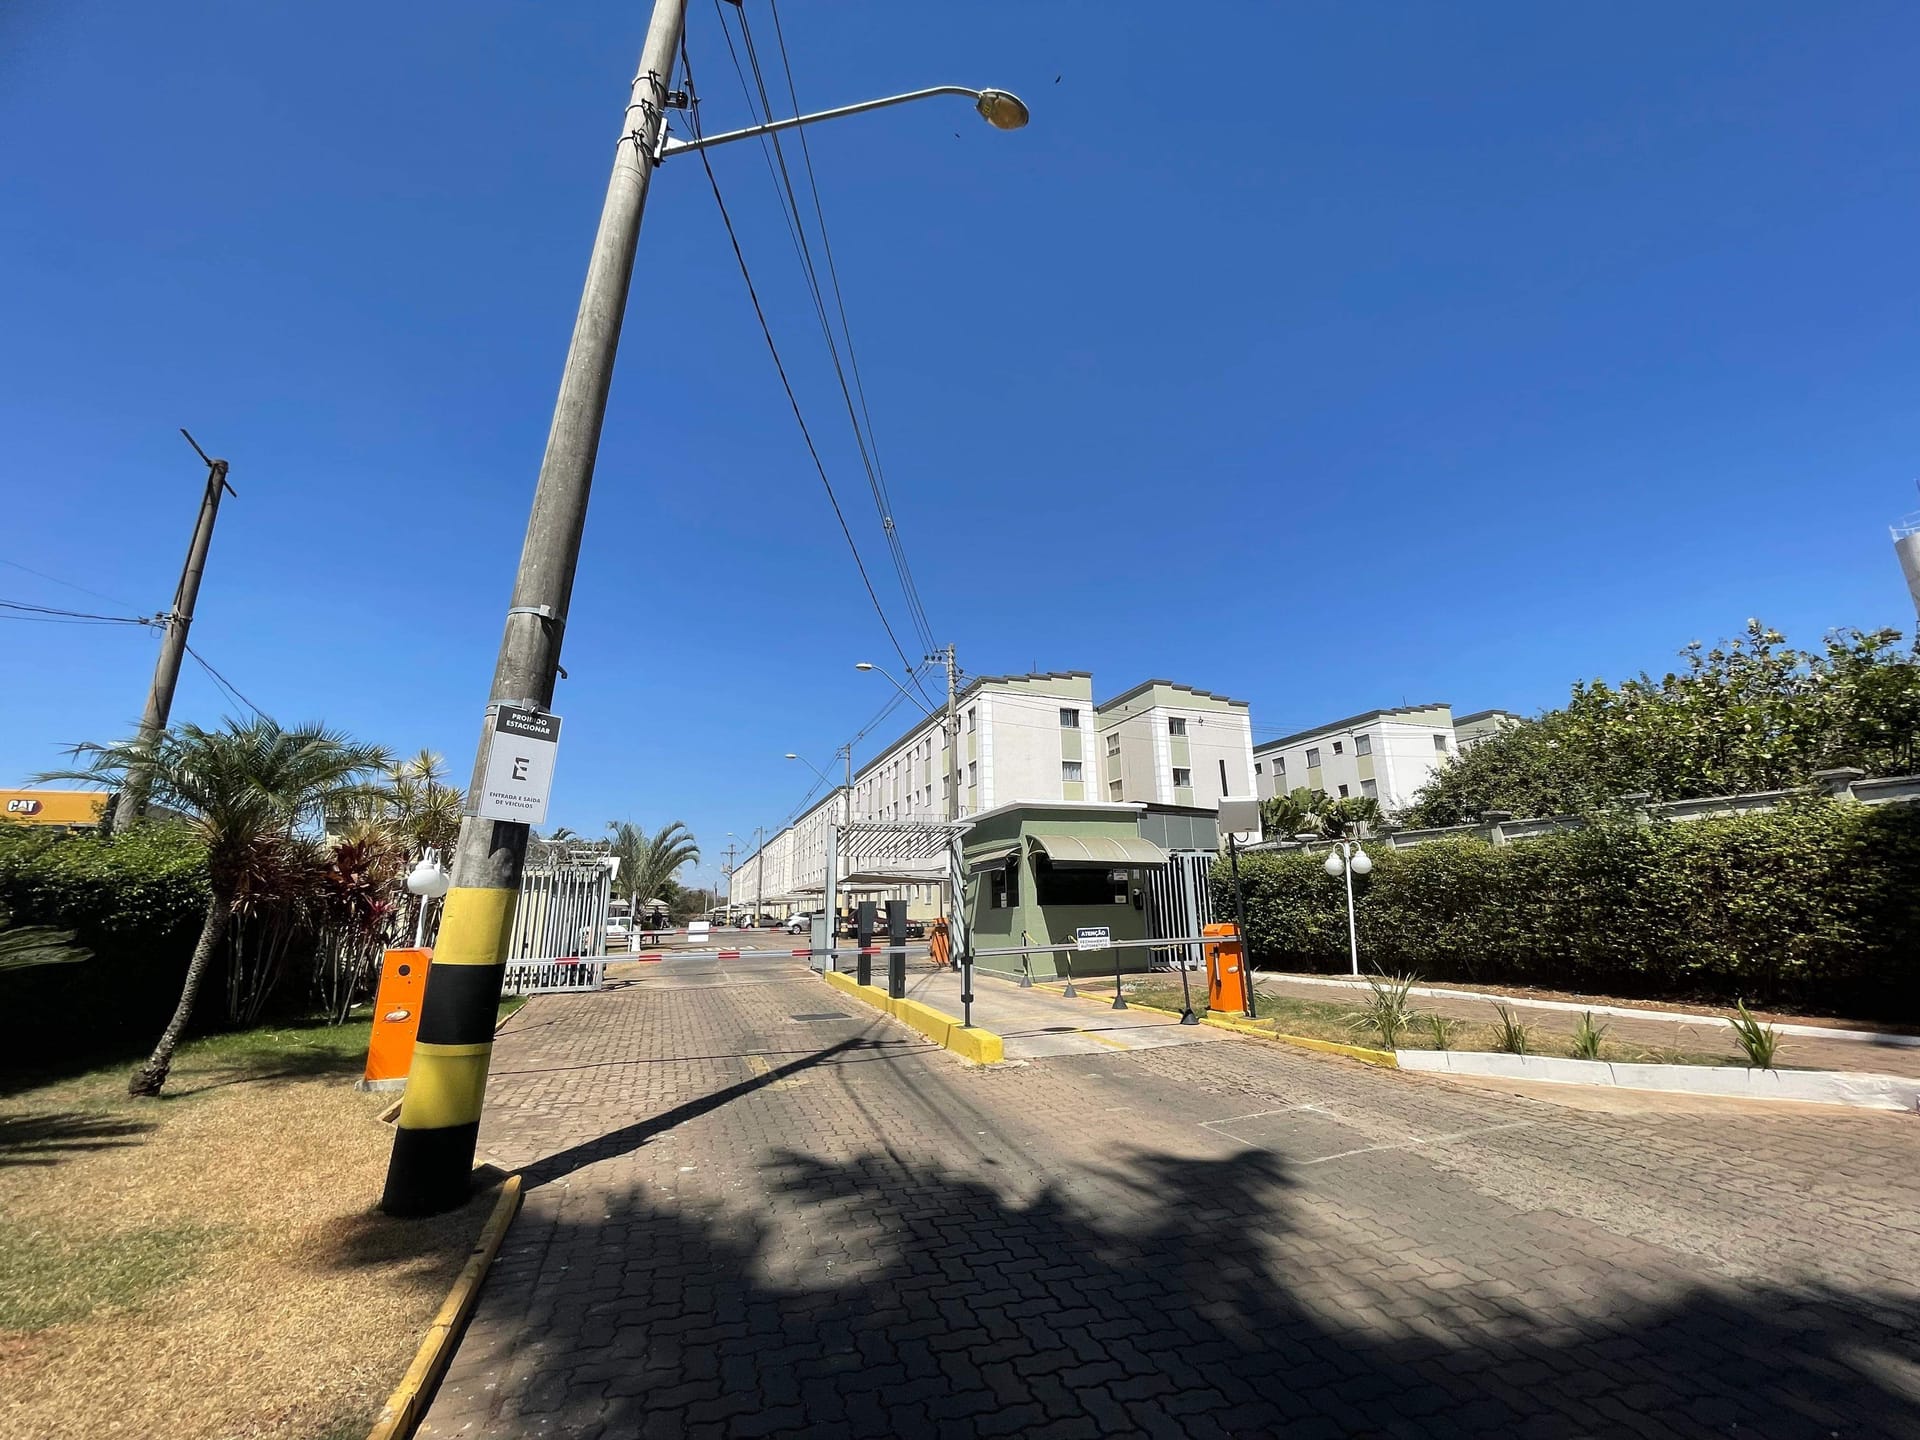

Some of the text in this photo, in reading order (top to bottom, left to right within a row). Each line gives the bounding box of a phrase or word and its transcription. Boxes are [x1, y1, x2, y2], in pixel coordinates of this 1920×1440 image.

[506, 720, 550, 734] ESTACIONAR
[490, 792, 517, 800] ENTRADA
[8, 800, 36, 812] CAT
[1081, 929, 1106, 938] ATENÇÃO
